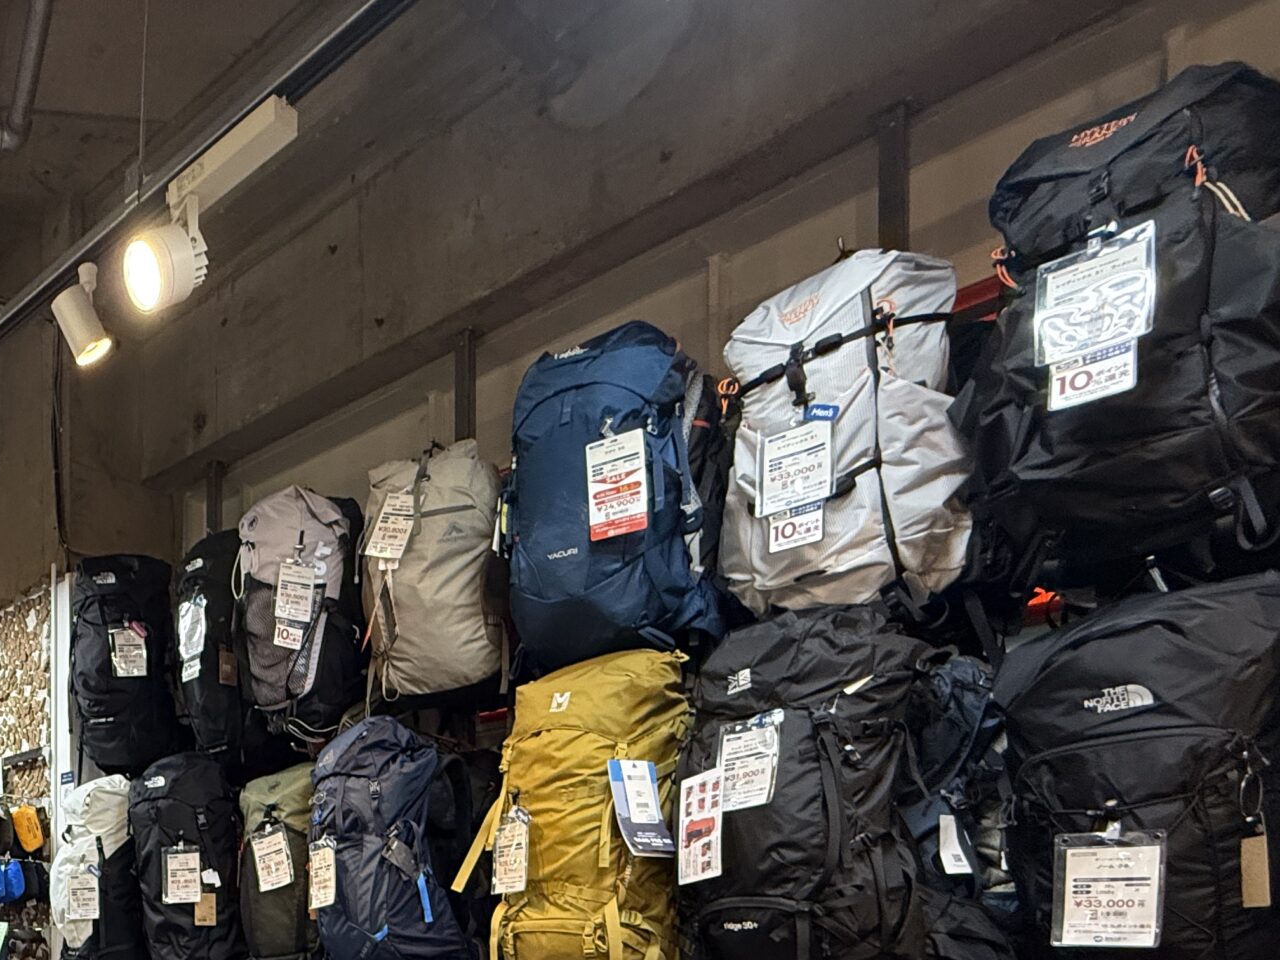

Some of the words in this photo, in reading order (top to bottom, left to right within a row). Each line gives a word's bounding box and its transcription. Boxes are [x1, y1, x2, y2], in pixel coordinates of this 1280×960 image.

[1056, 370, 1094, 396] 10
[811, 407, 834, 417] Men's
[769, 464, 816, 482] ¥33,000
[596, 497, 635, 512] ¥24,900
[772, 521, 797, 542] 10
[547, 547, 578, 560] YACURI
[276, 626, 290, 641] 10
[1102, 685, 1127, 697] THE
[1083, 694, 1127, 709] NORTH
[1097, 702, 1129, 714] FACE
[1073, 898, 1136, 909] ¥33,000
